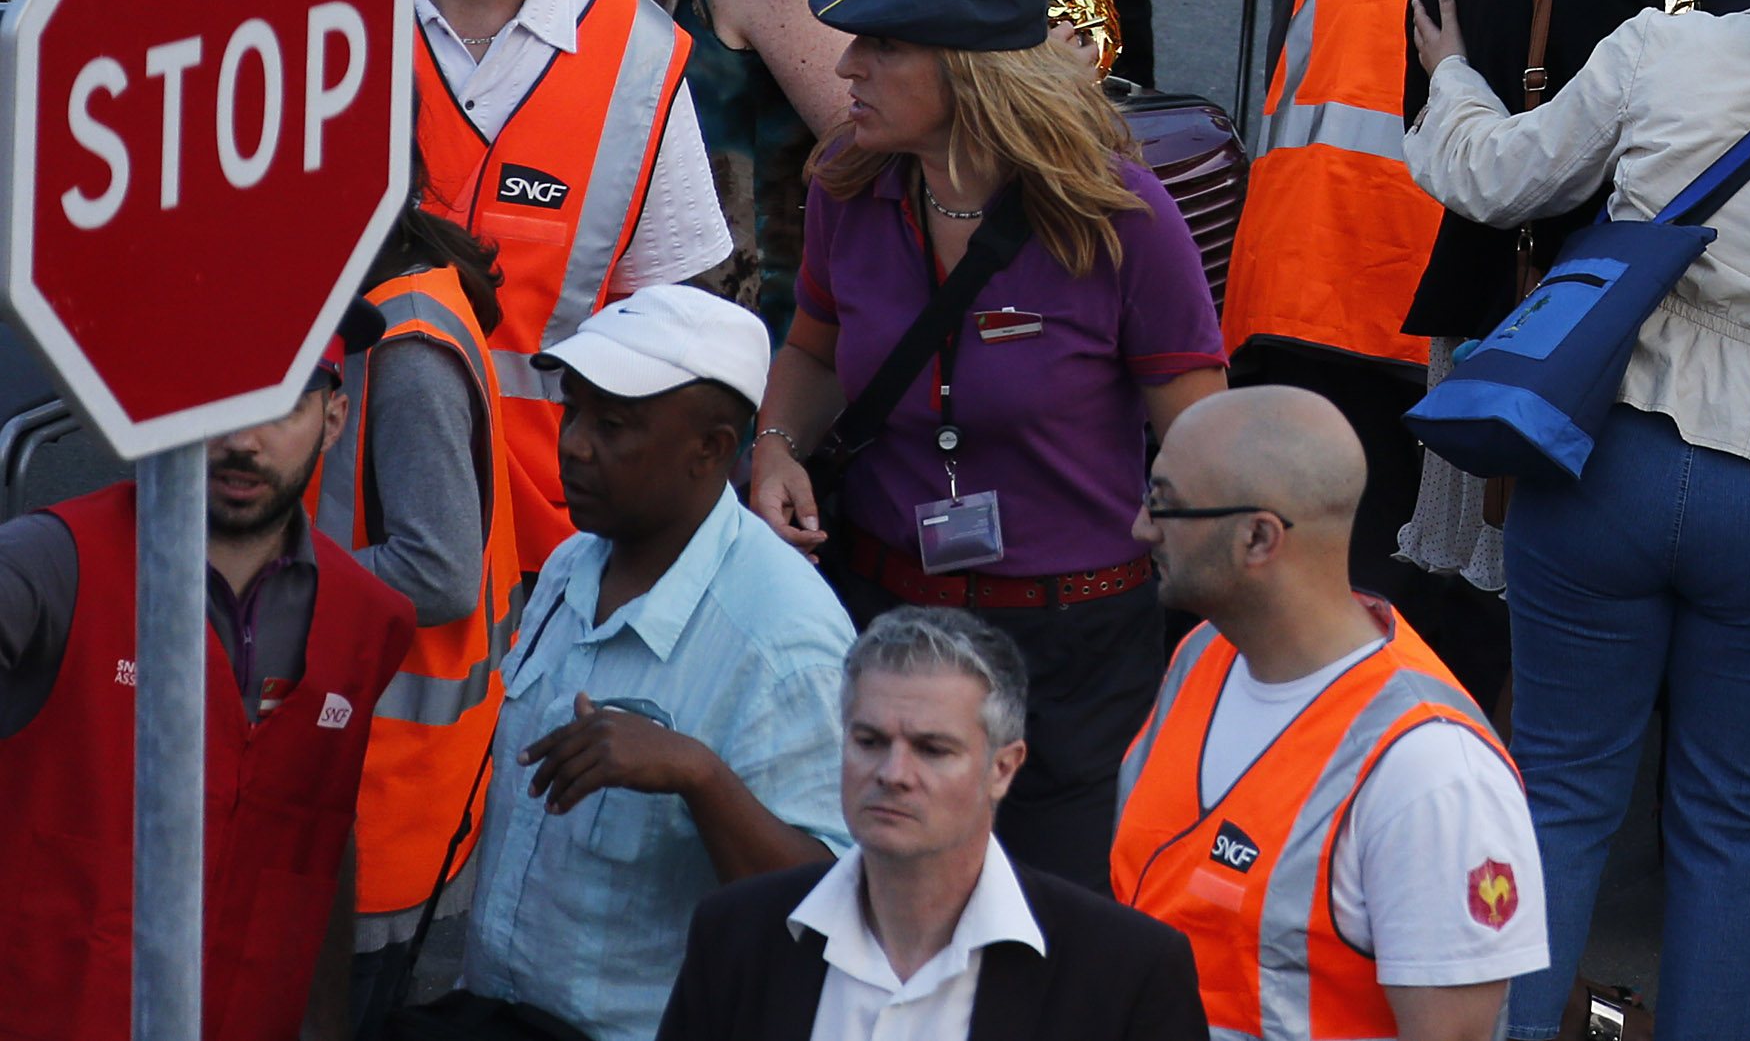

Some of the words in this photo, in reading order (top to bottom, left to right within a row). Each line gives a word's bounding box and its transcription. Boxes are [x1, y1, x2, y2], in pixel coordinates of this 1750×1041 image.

[61, 1, 368, 231] STOP
[500, 177, 567, 202] SNCF
[117, 659, 136, 673] SN
[321, 707, 349, 722] SNCF
[1211, 835, 1258, 865] SNCF
